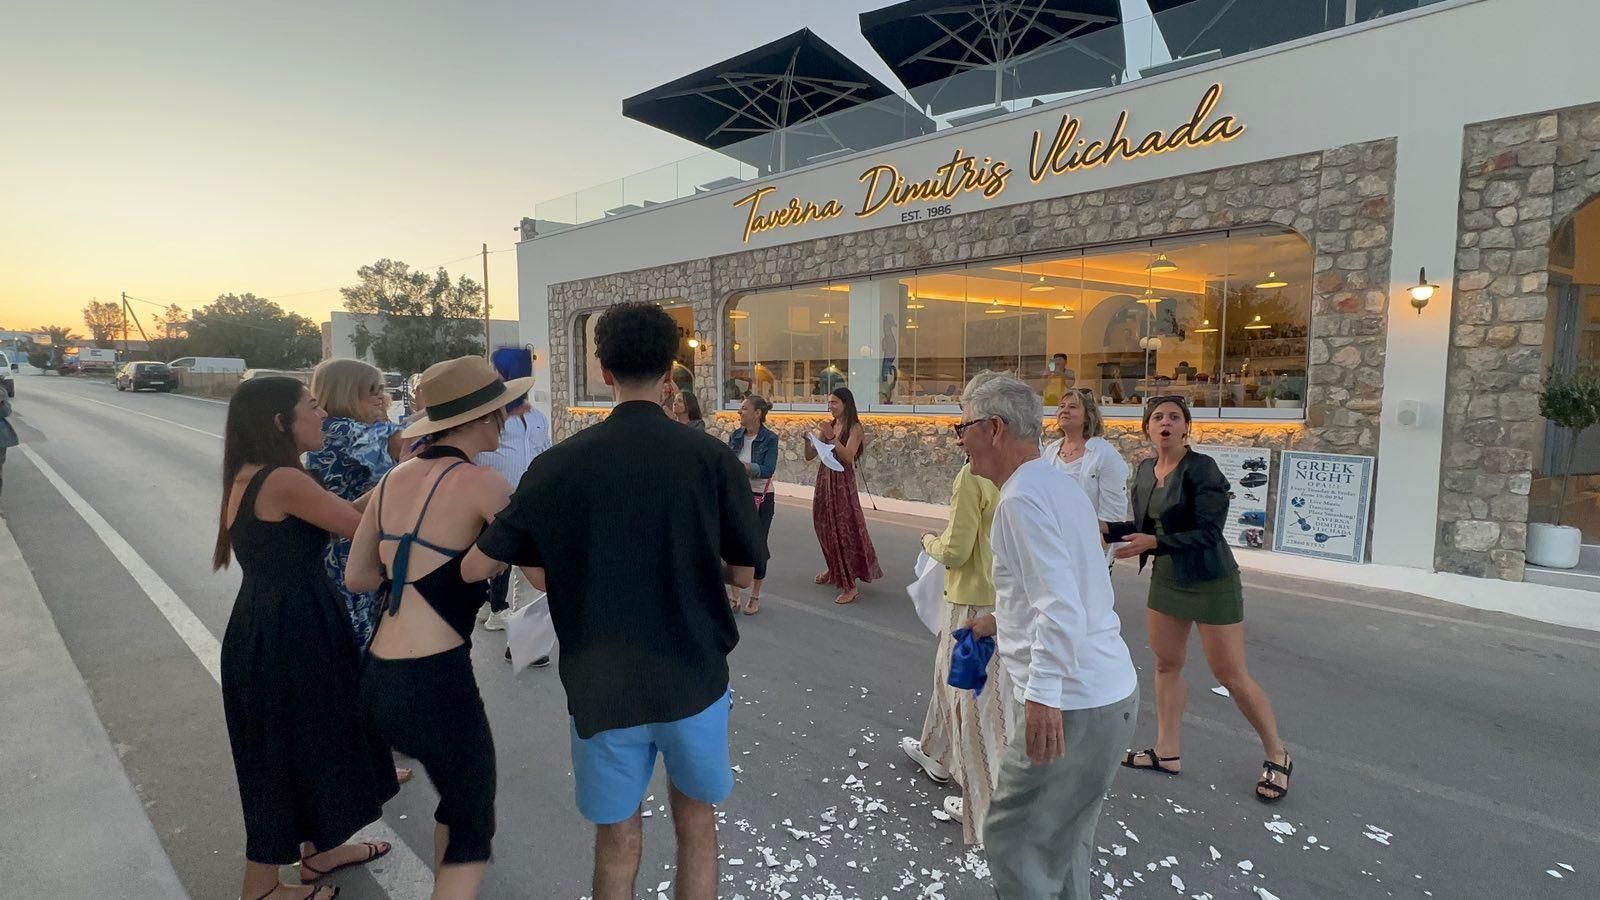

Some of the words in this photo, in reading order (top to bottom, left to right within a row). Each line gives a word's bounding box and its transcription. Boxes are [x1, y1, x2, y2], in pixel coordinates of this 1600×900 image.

[733, 186, 843, 244] Taverna
[854, 147, 1012, 217] Dimitris
[1028, 82, 1247, 185] Vlichada
[901, 209, 922, 223] EST.
[926, 204, 952, 218] 1986
[1296, 460, 1355, 474] GREEK
[1295, 470, 1355, 484] NIGHT
[1315, 521, 1350, 530] DIMITRIS
[1316, 516, 1350, 525] TAVERNA
[1312, 526, 1352, 536] VLICHADA
